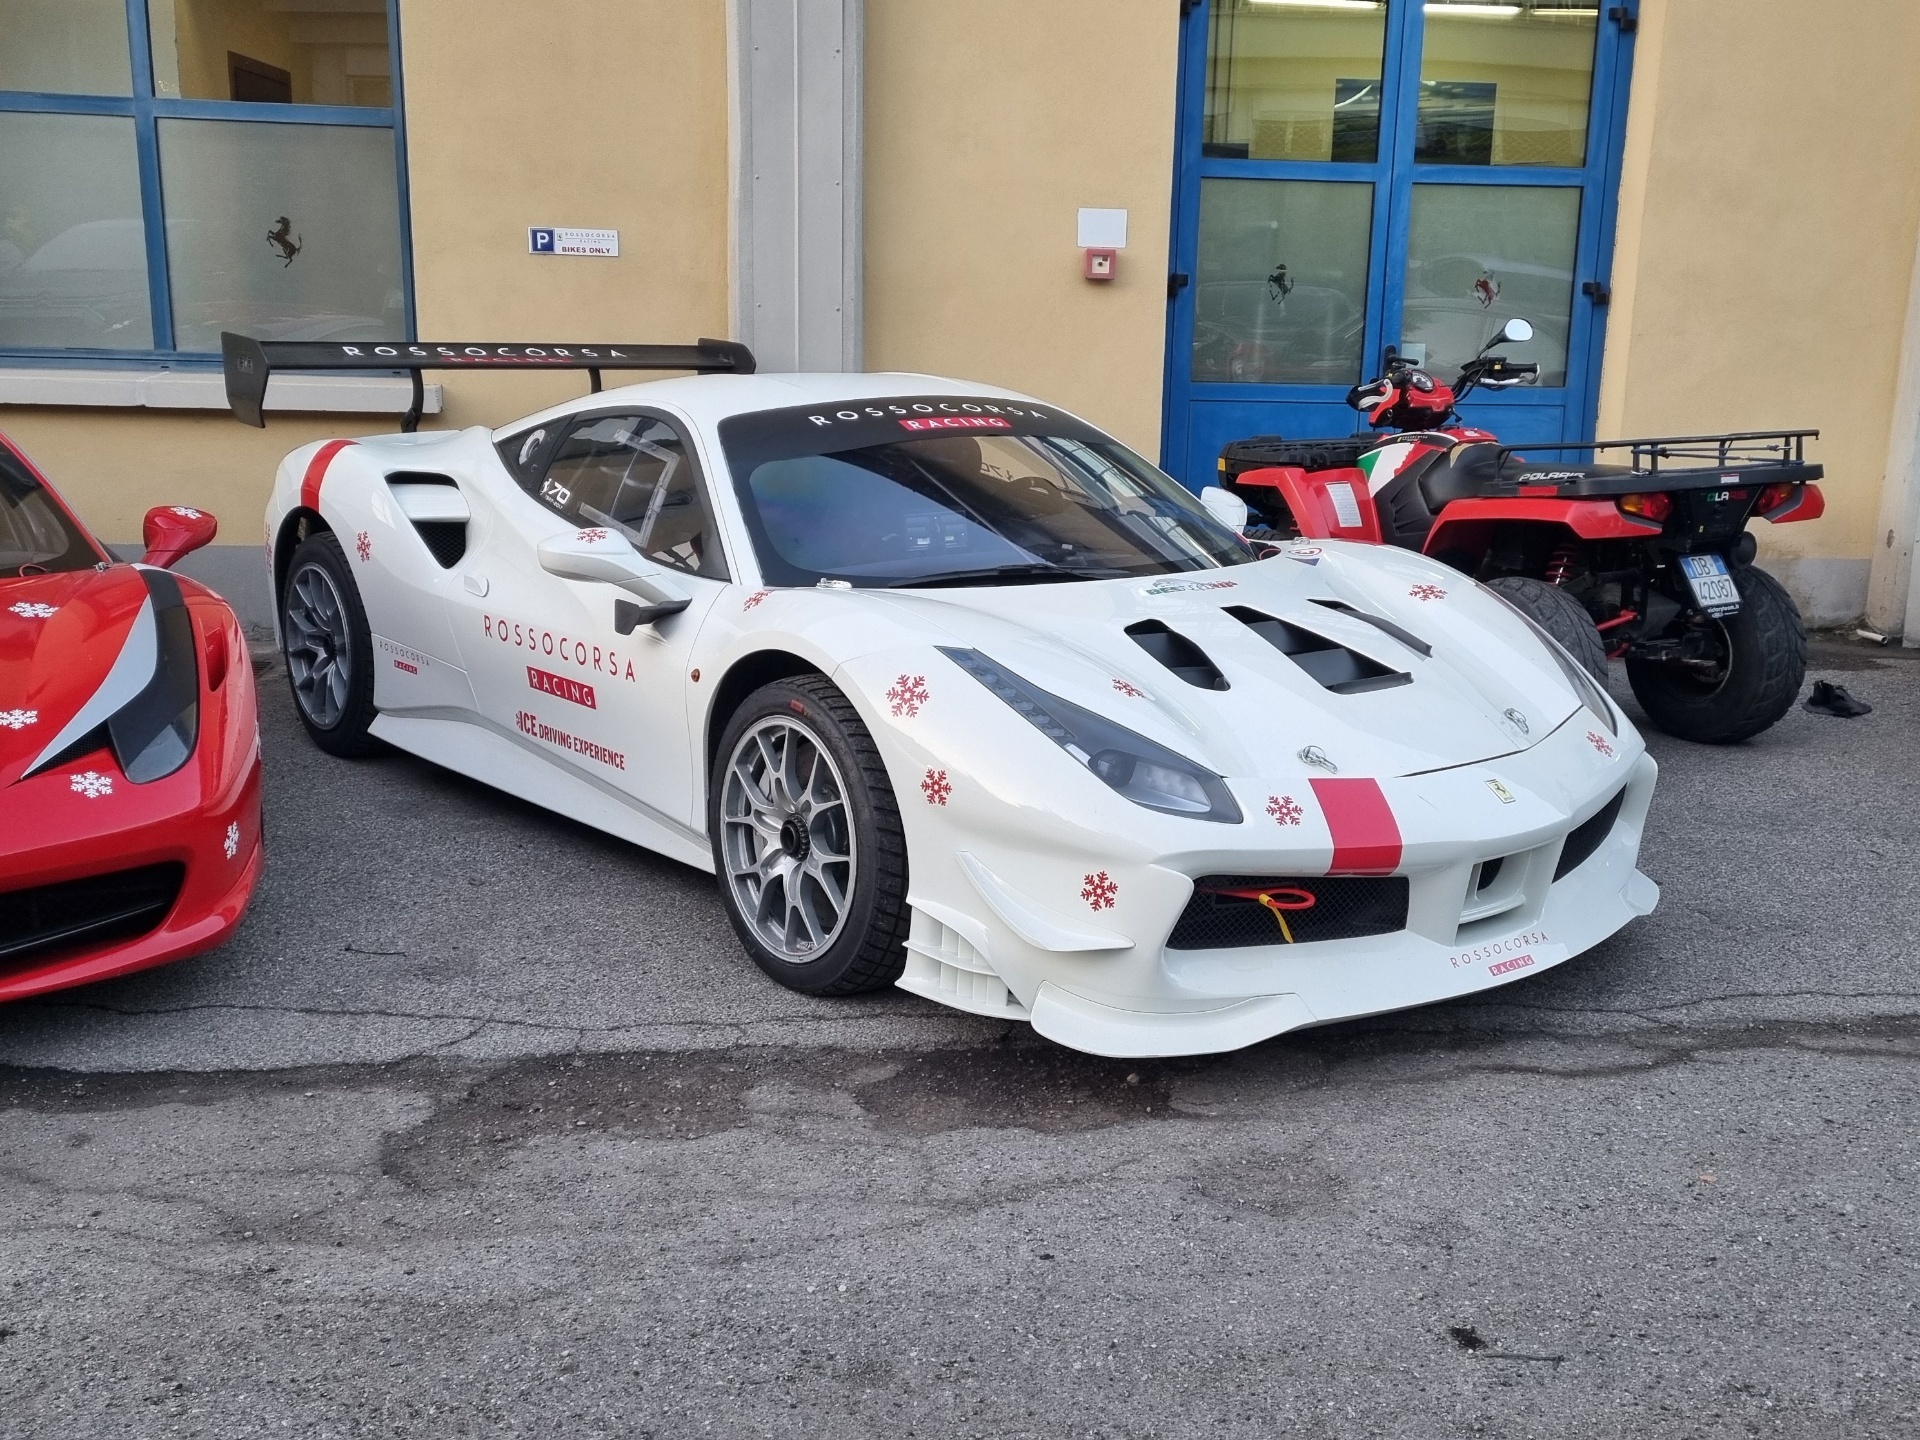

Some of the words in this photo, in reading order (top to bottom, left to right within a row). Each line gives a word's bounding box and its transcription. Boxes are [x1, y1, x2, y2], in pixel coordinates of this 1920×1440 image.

[536, 232, 549, 249] P
[562, 246, 587, 254] BIKES
[342, 346, 628, 357] ROSSOCORSA
[808, 403, 1048, 426] ROSSOCORSA
[907, 418, 1005, 429] RACING
[548, 481, 571, 505] 70
[1691, 557, 1711, 576] DB
[1700, 579, 1733, 600] 42087
[380, 641, 430, 666] ROSSOCORSA
[484, 615, 635, 682] ROSSOCORSA
[531, 670, 592, 706] RACING
[518, 711, 537, 737] ICE
[539, 723, 572, 750] DRIVING
[574, 736, 625, 771] EXPERIENCE
[1450, 930, 1549, 969] ROSSOCORSA
[1491, 955, 1533, 976] RACING
